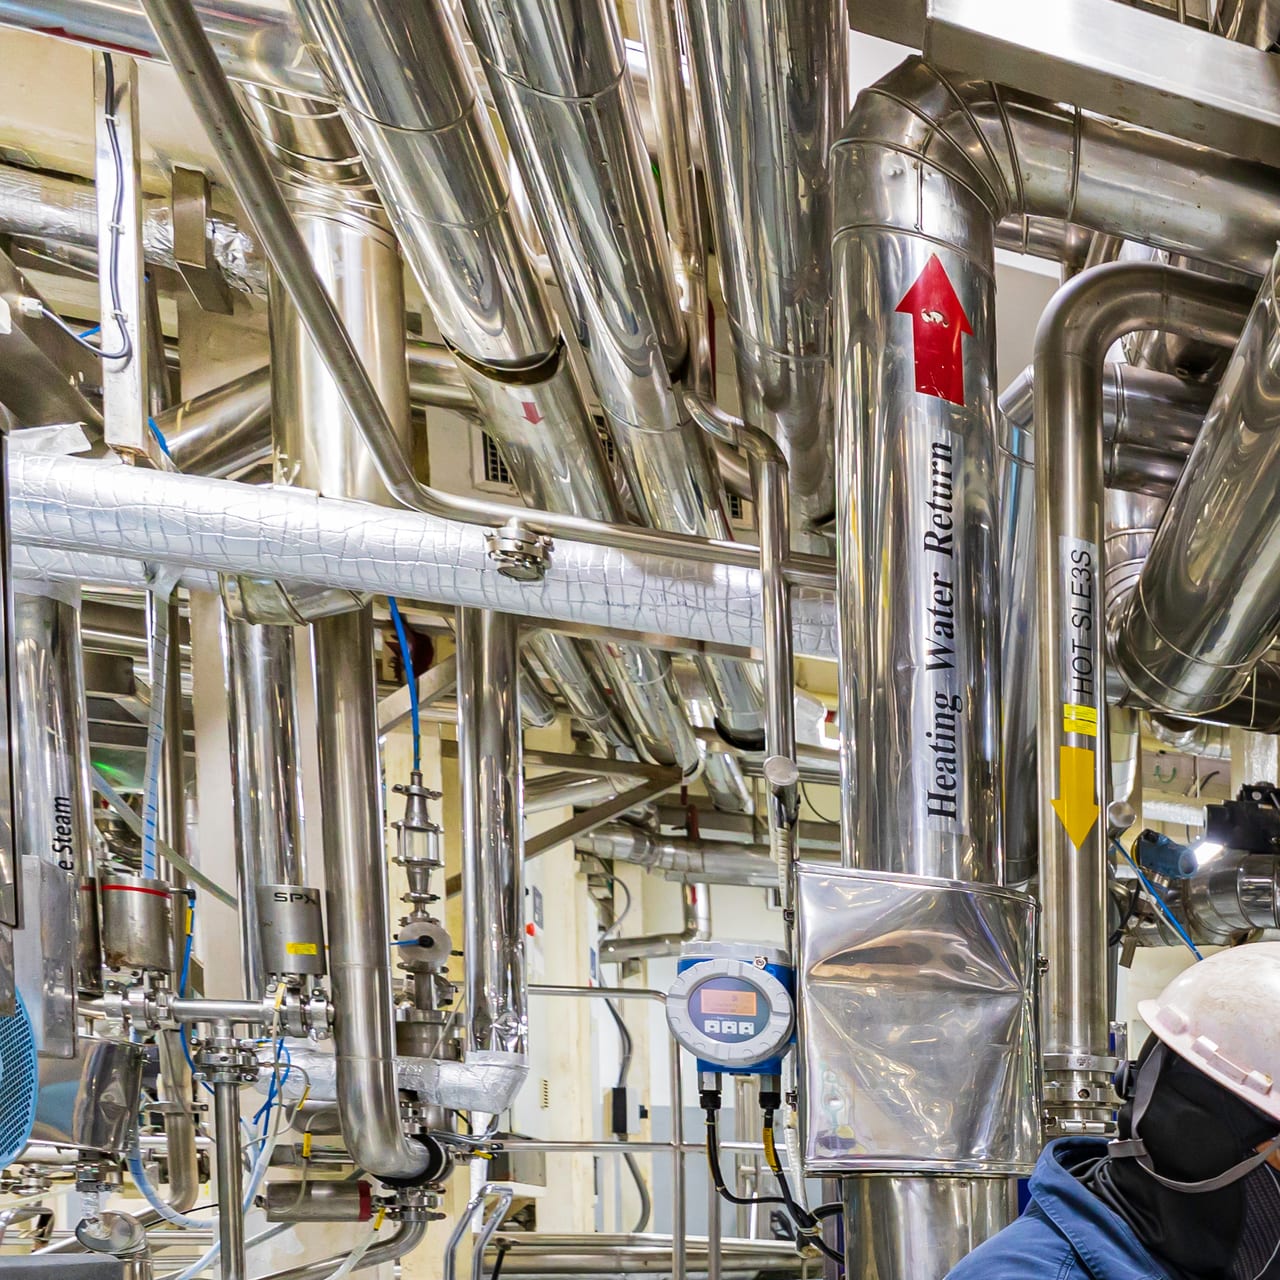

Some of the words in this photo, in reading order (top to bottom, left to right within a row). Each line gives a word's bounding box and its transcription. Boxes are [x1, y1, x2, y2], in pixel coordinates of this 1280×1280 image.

[924, 441, 953, 560] Return
[925, 571, 956, 672] Water
[1071, 549, 1092, 631] SLE3S
[1071, 638, 1093, 696] HOT
[926, 691, 962, 822] Heating
[52, 796, 73, 855] Steam
